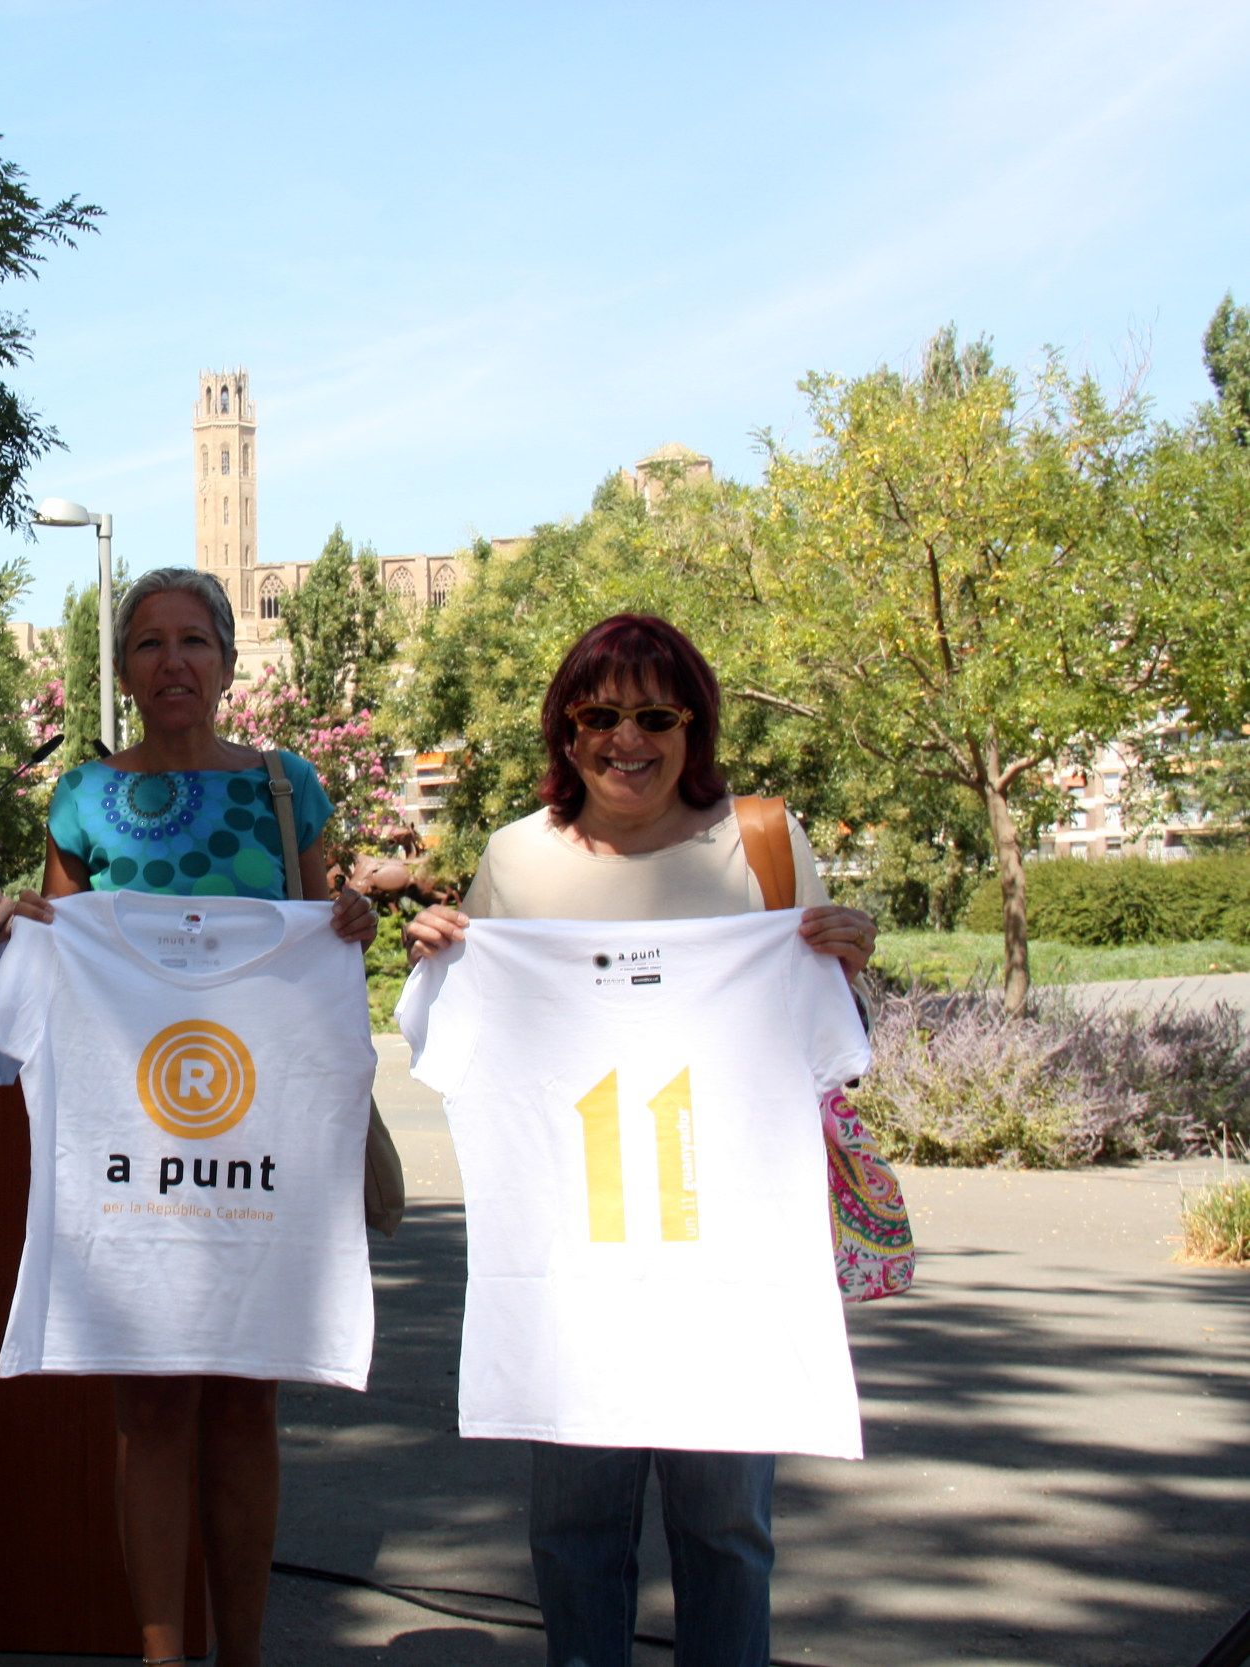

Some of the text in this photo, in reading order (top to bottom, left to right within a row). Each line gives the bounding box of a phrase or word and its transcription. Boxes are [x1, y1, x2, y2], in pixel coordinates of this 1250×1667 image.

[631, 948, 660, 961] punt
[178, 1058, 216, 1099] R
[574, 1065, 699, 1242] 11
[107, 1154, 276, 1194] a punt
[103, 1202, 274, 1221] per la República Catalana
